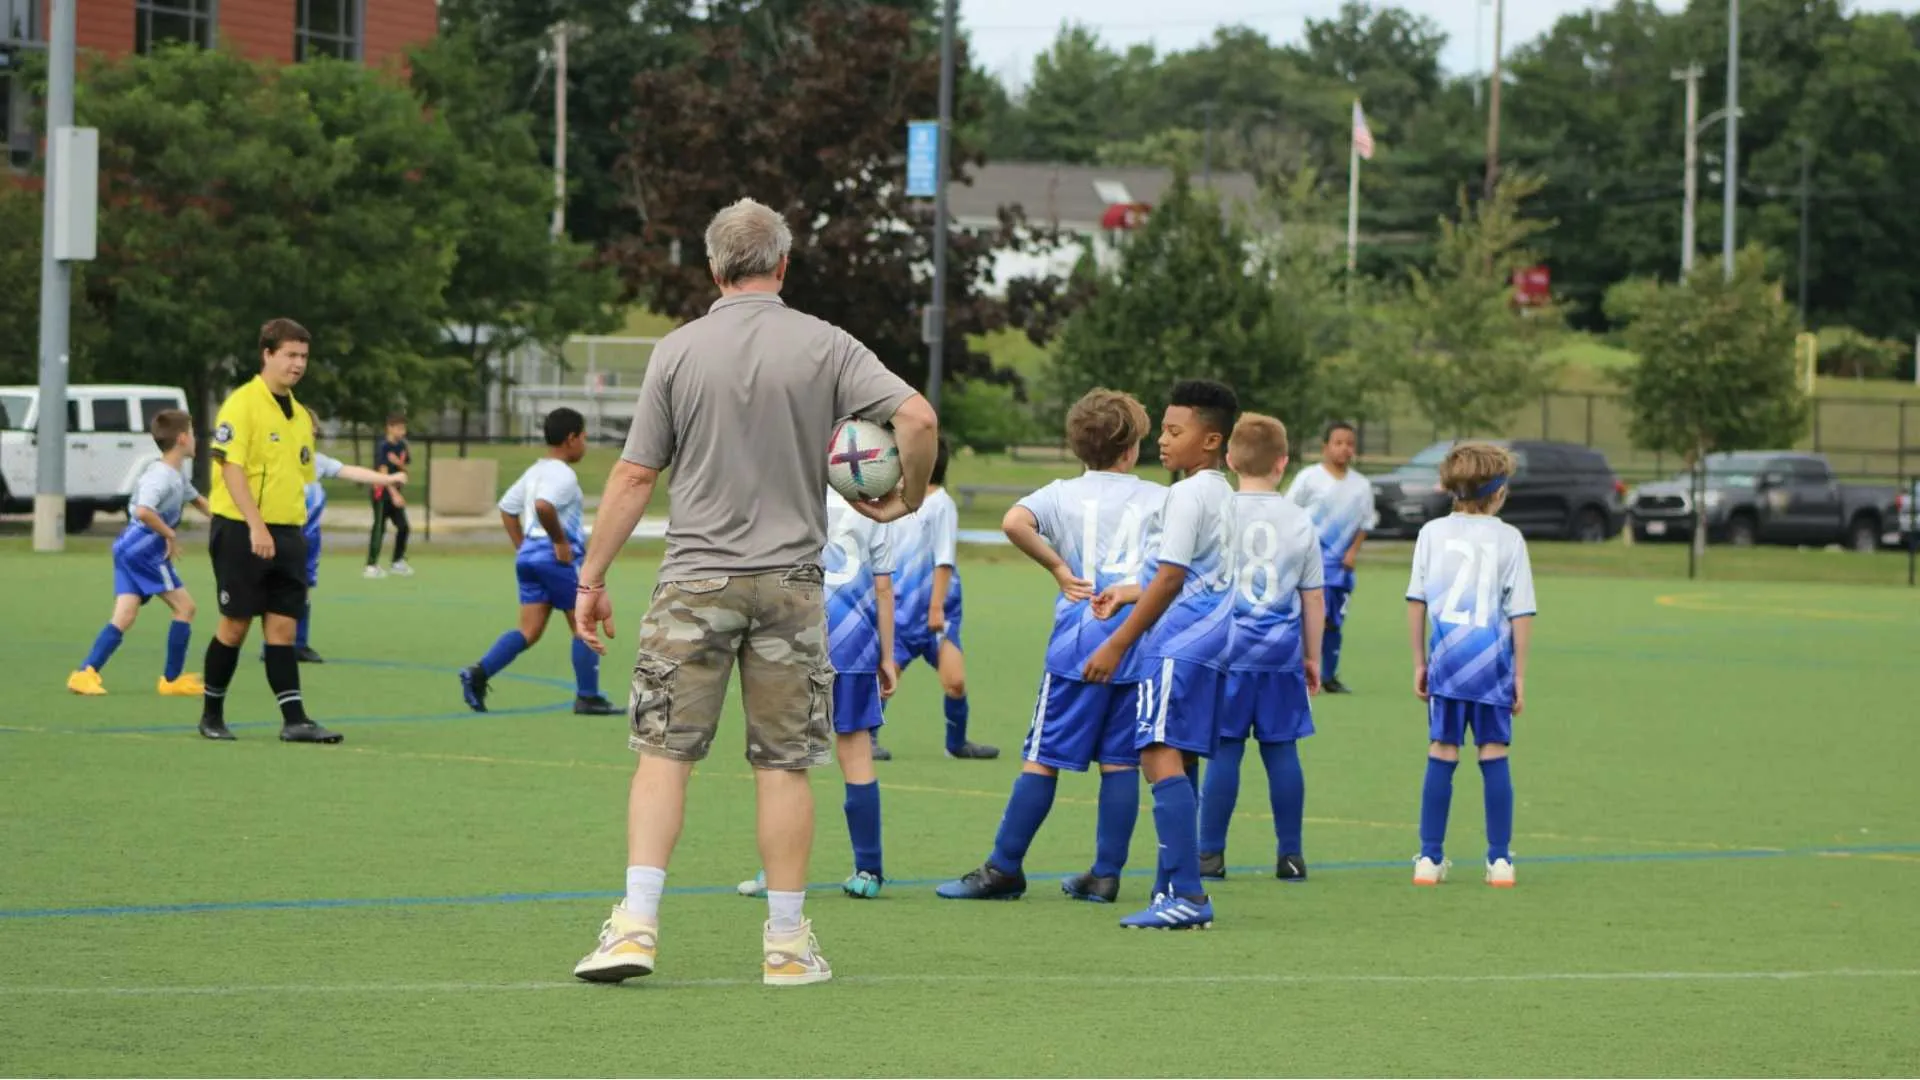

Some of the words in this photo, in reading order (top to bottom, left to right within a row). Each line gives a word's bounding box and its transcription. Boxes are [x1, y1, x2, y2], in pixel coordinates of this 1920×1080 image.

[1082, 499, 1143, 590] 14
[1240, 520, 1278, 605] 8
[1440, 539, 1498, 628] 21
